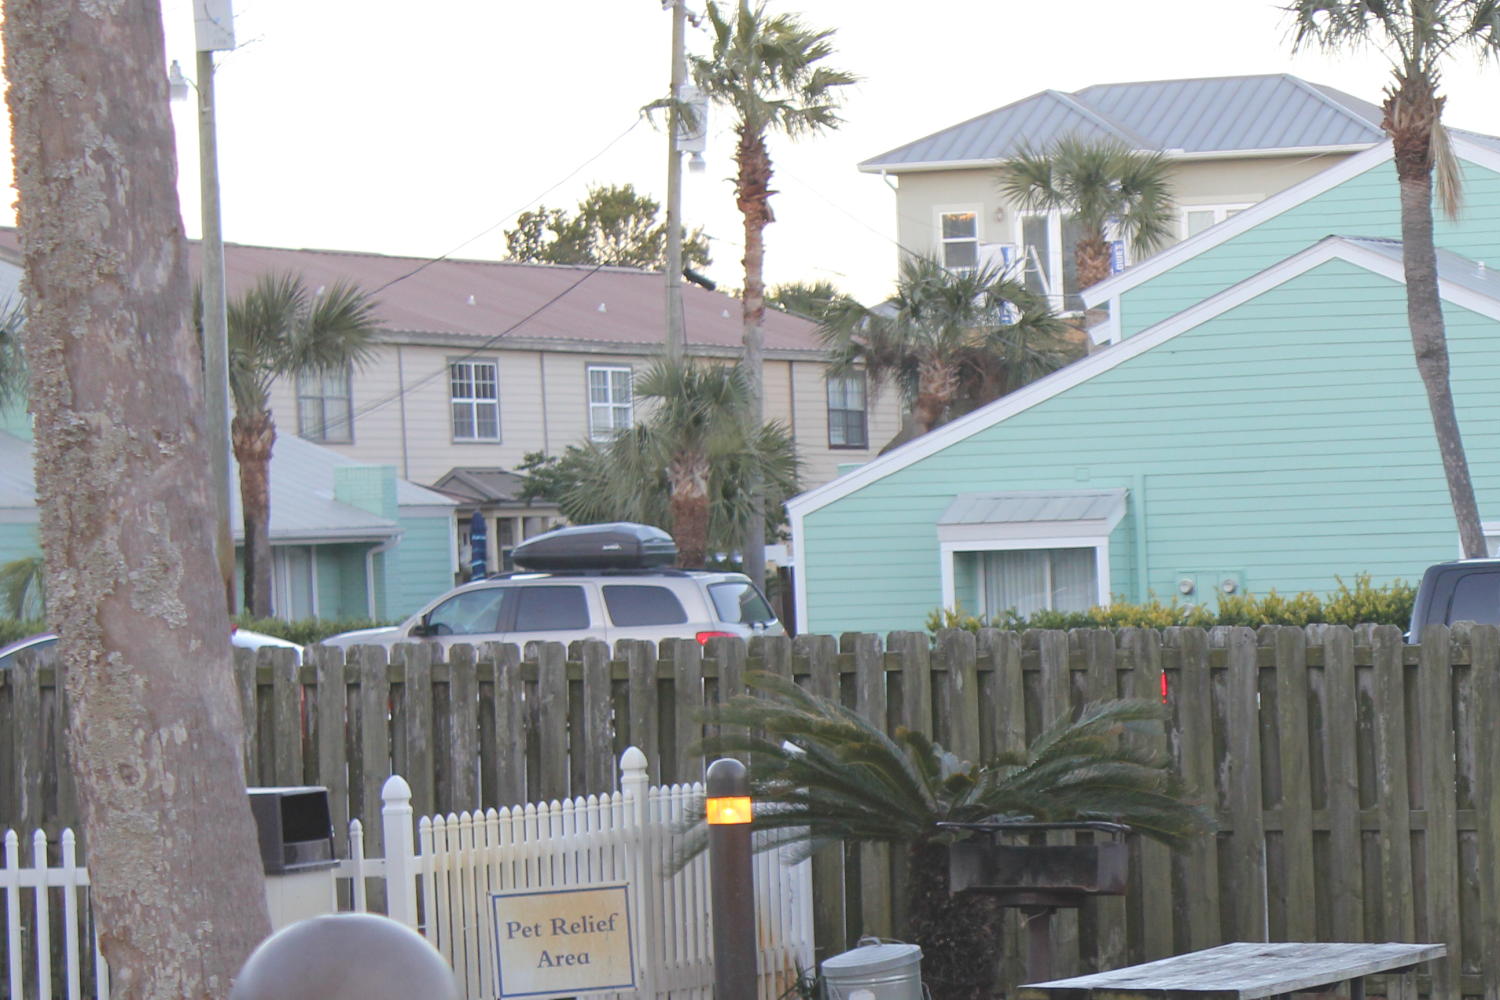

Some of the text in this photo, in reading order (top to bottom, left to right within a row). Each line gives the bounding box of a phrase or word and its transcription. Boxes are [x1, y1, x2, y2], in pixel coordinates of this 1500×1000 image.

[506, 912, 619, 940] Pet Relief
[536, 949, 591, 969] Area
